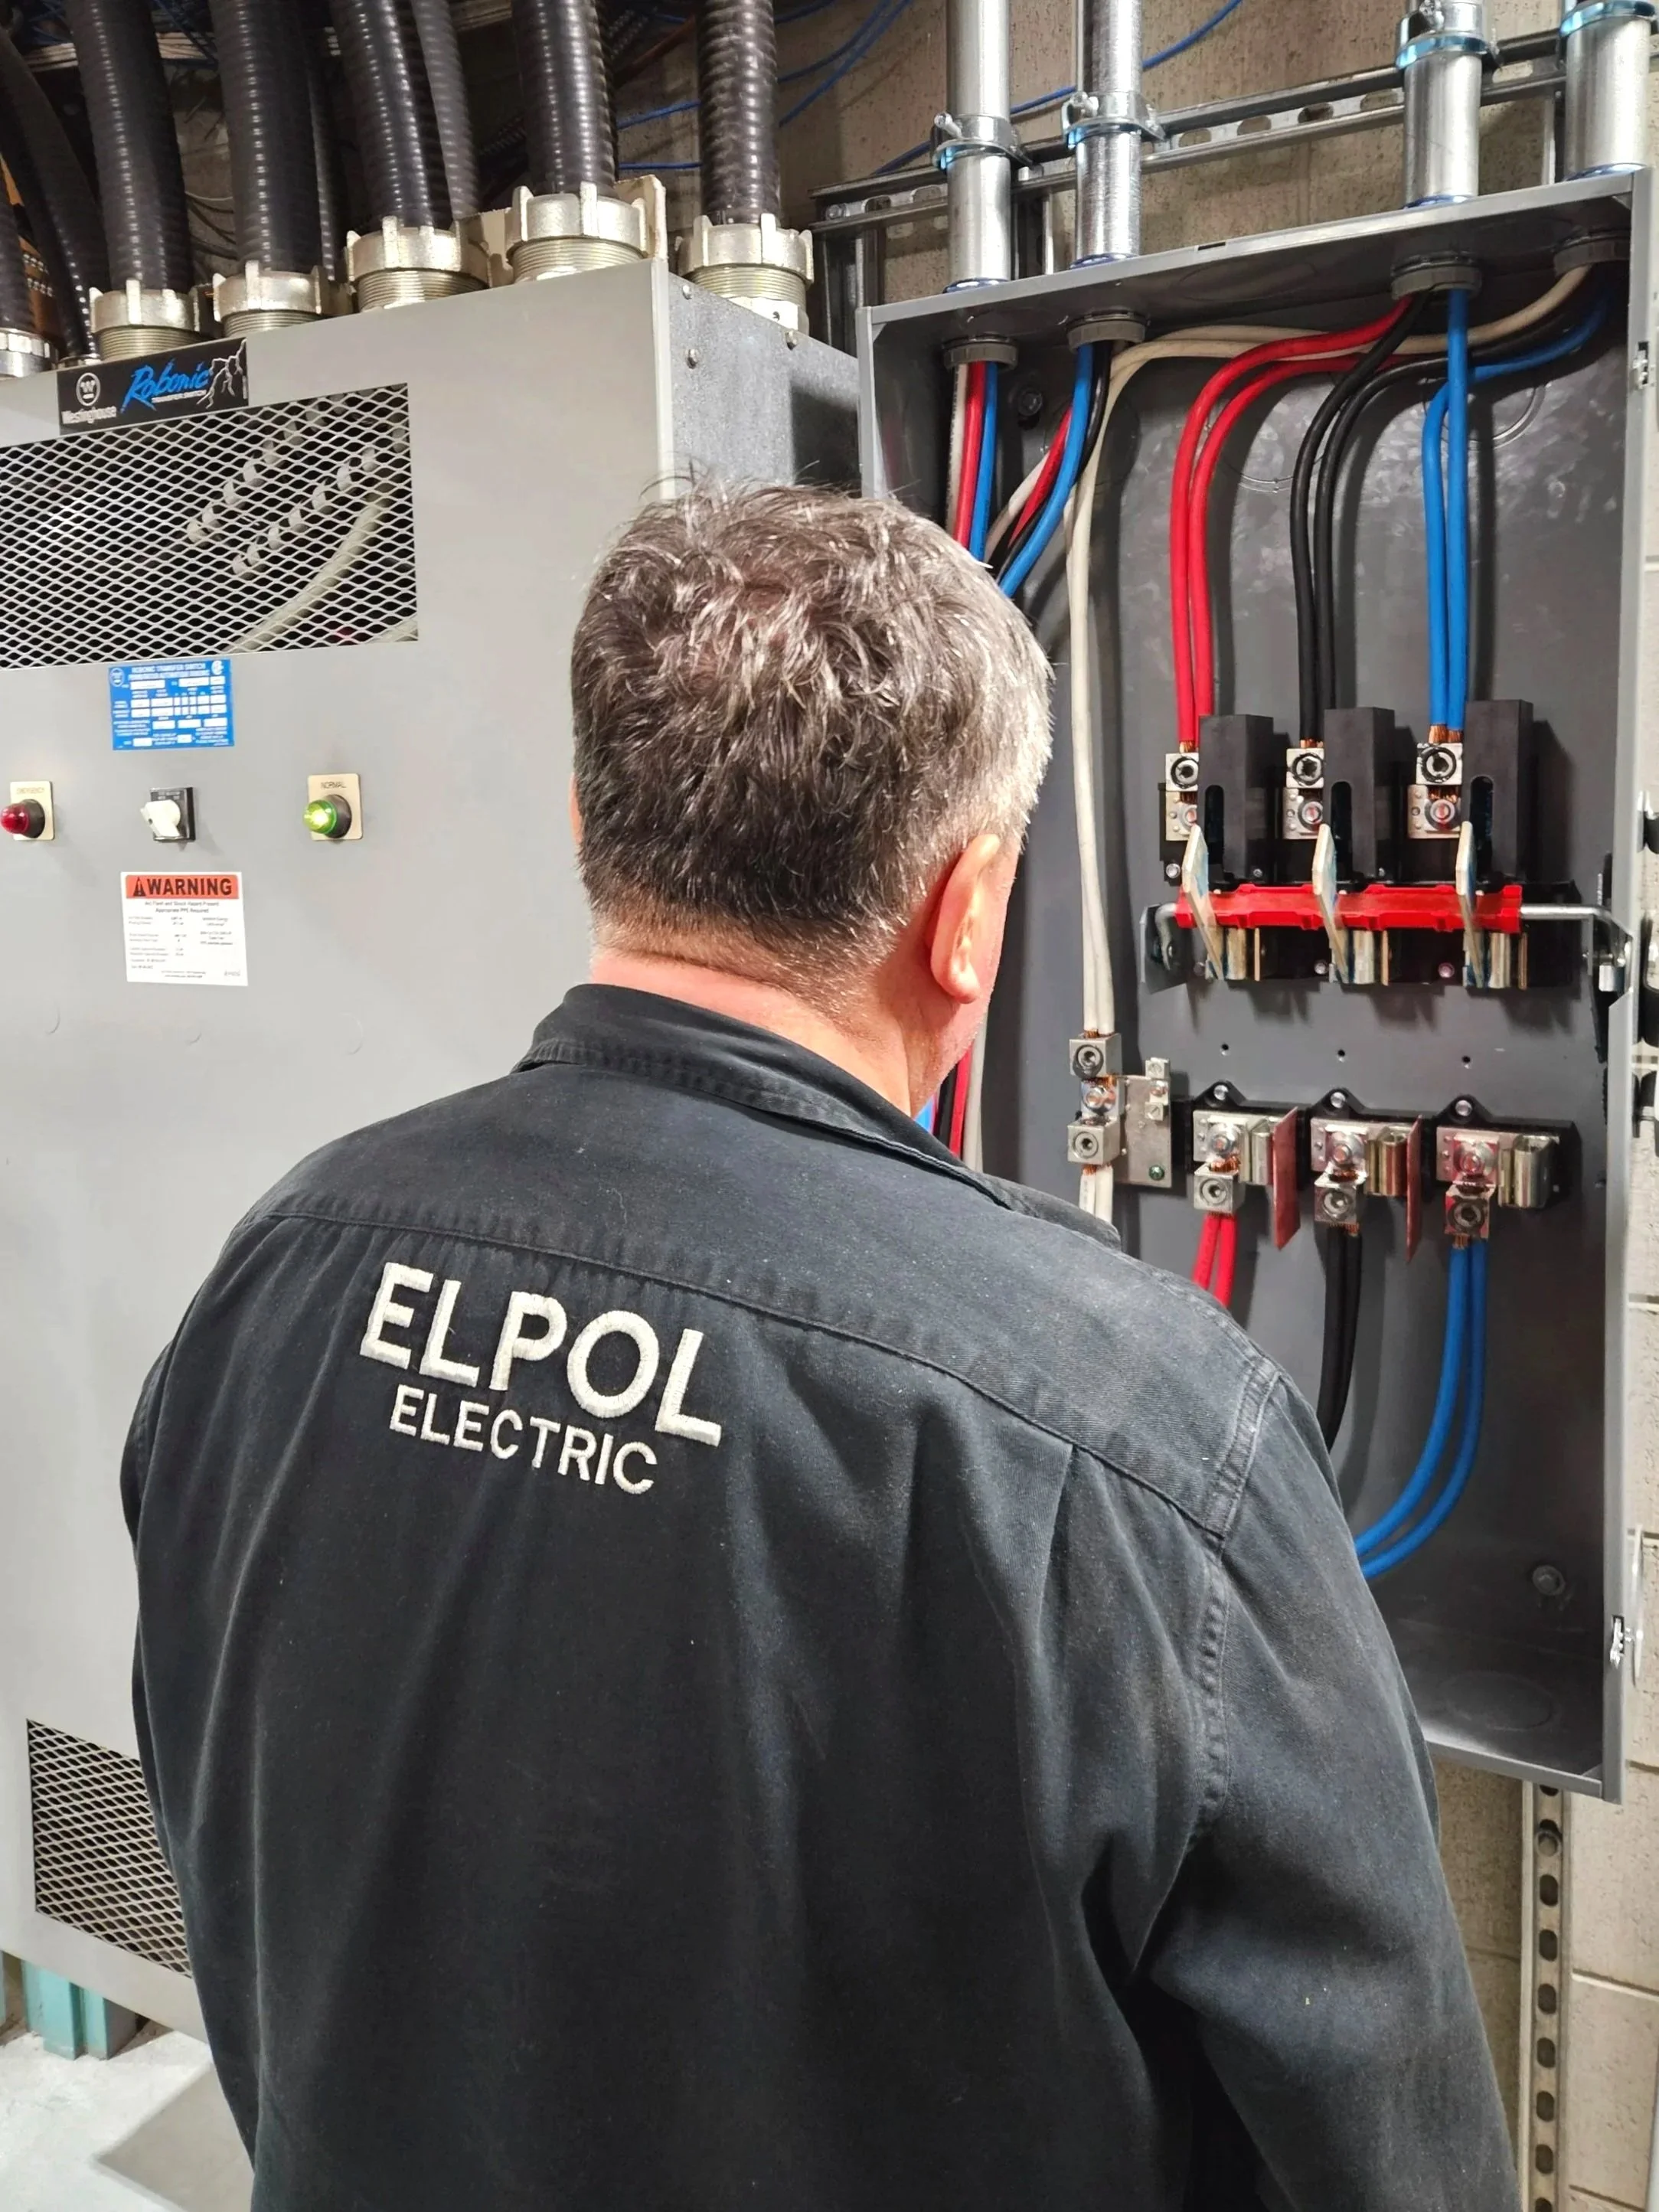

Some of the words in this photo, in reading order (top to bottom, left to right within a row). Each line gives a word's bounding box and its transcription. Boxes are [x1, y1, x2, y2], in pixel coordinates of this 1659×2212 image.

[119, 358, 209, 413] Robonic
[61, 406, 117, 424] Westinghouse
[146, 878, 233, 896] WARNING
[359, 1261, 722, 1447] ELPOL
[389, 1384, 658, 1495] ELECTRIC
